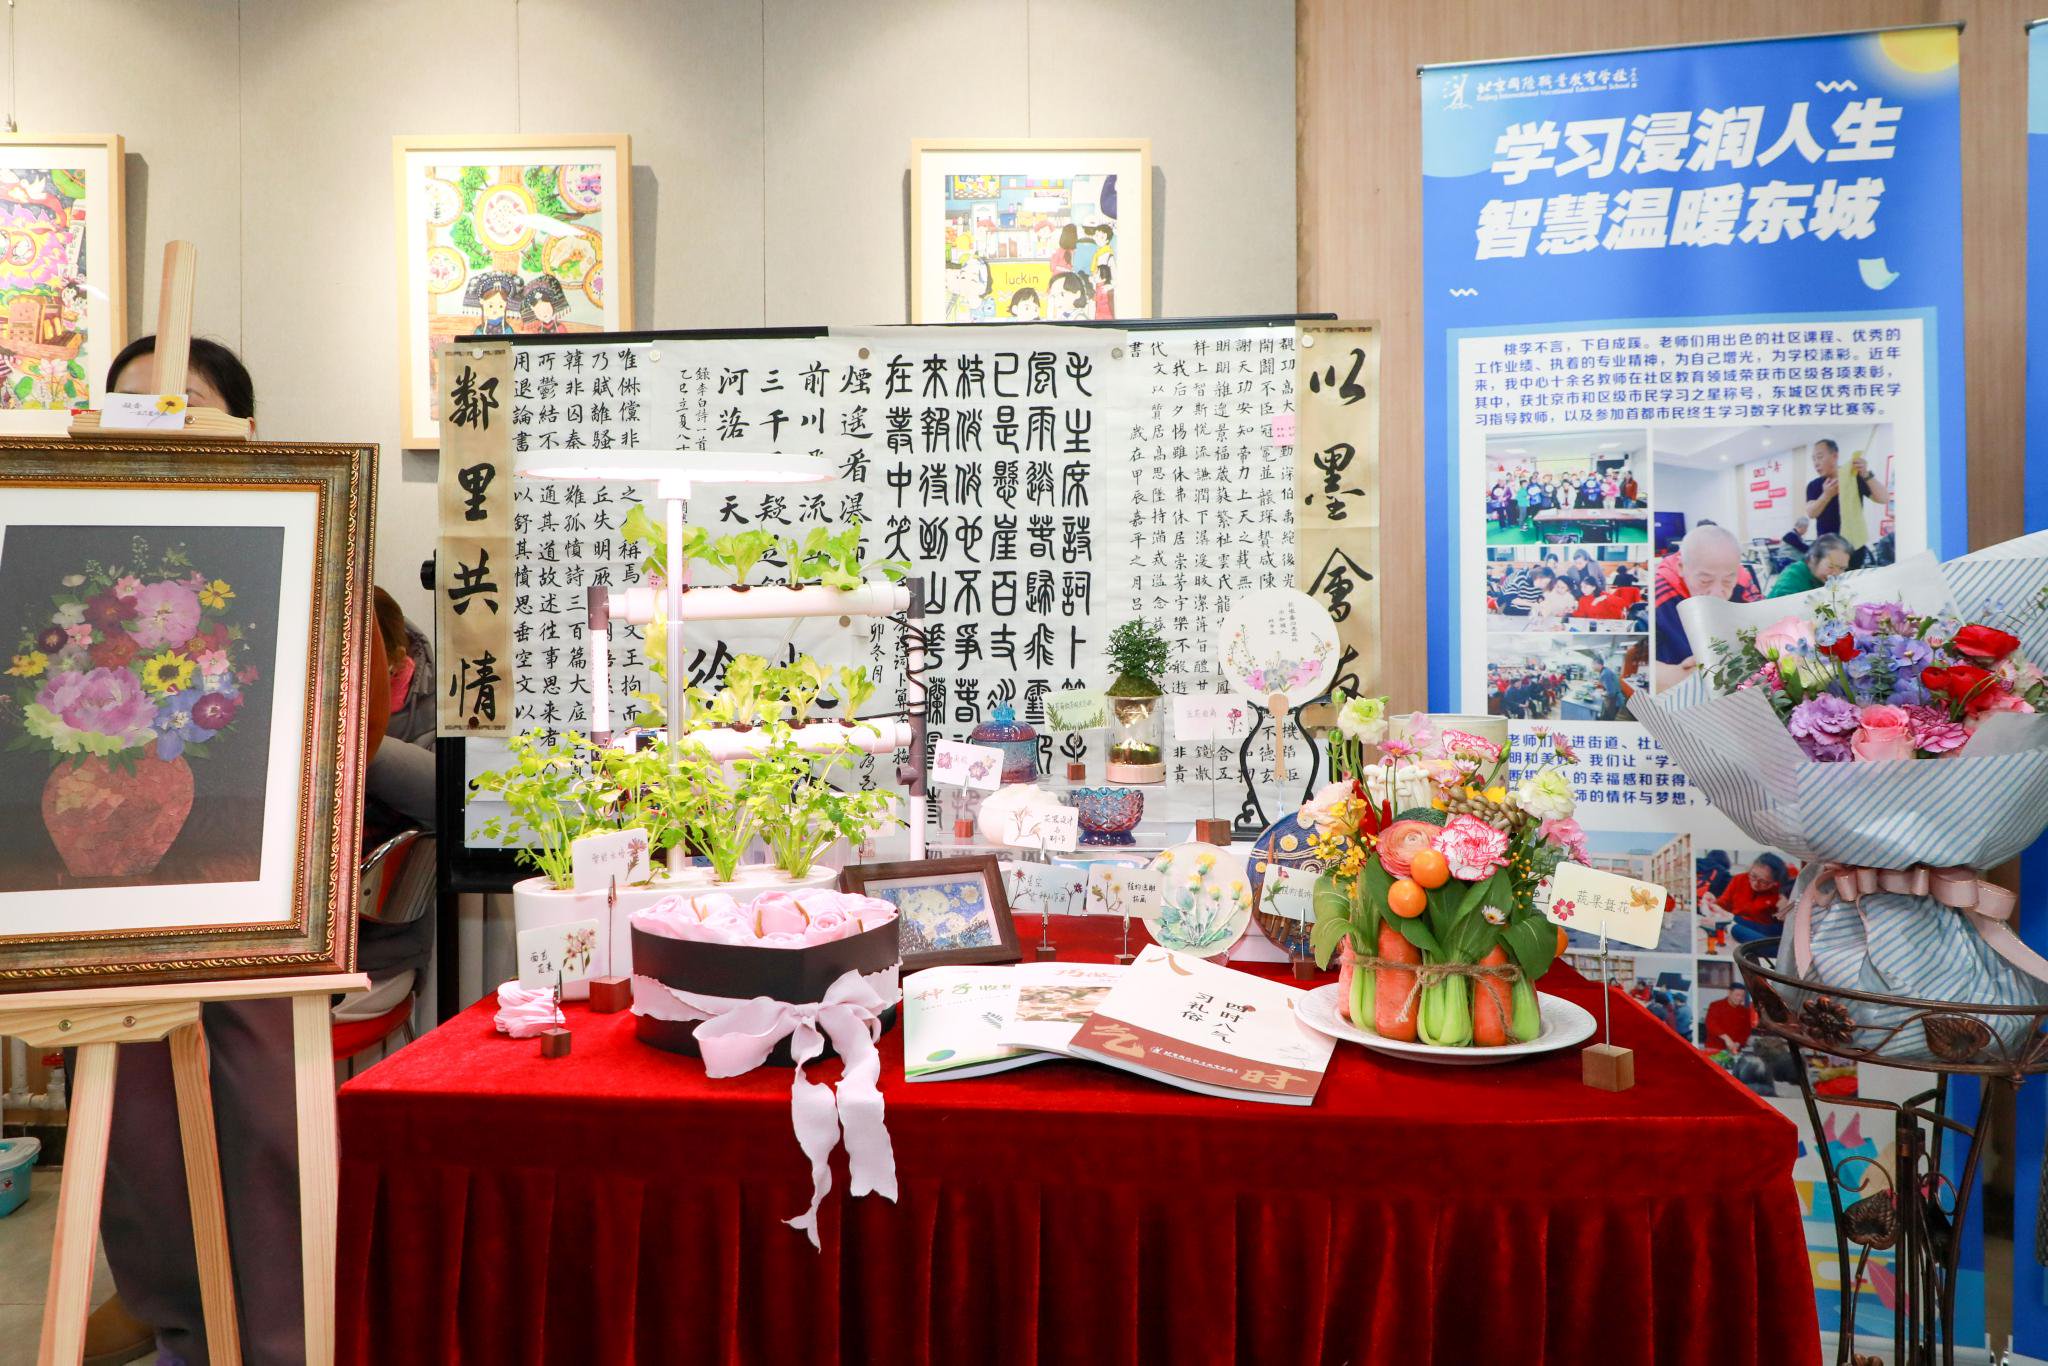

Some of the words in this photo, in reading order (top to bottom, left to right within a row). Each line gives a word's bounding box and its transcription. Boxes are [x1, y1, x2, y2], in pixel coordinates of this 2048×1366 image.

[1491, 97, 1903, 185] 学习浸润人生
[1475, 177, 1885, 261] 智慧温暖东城
[1180, 992, 1214, 1024] 习礼俗
[1210, 1001, 1249, 1045] 四时八气
